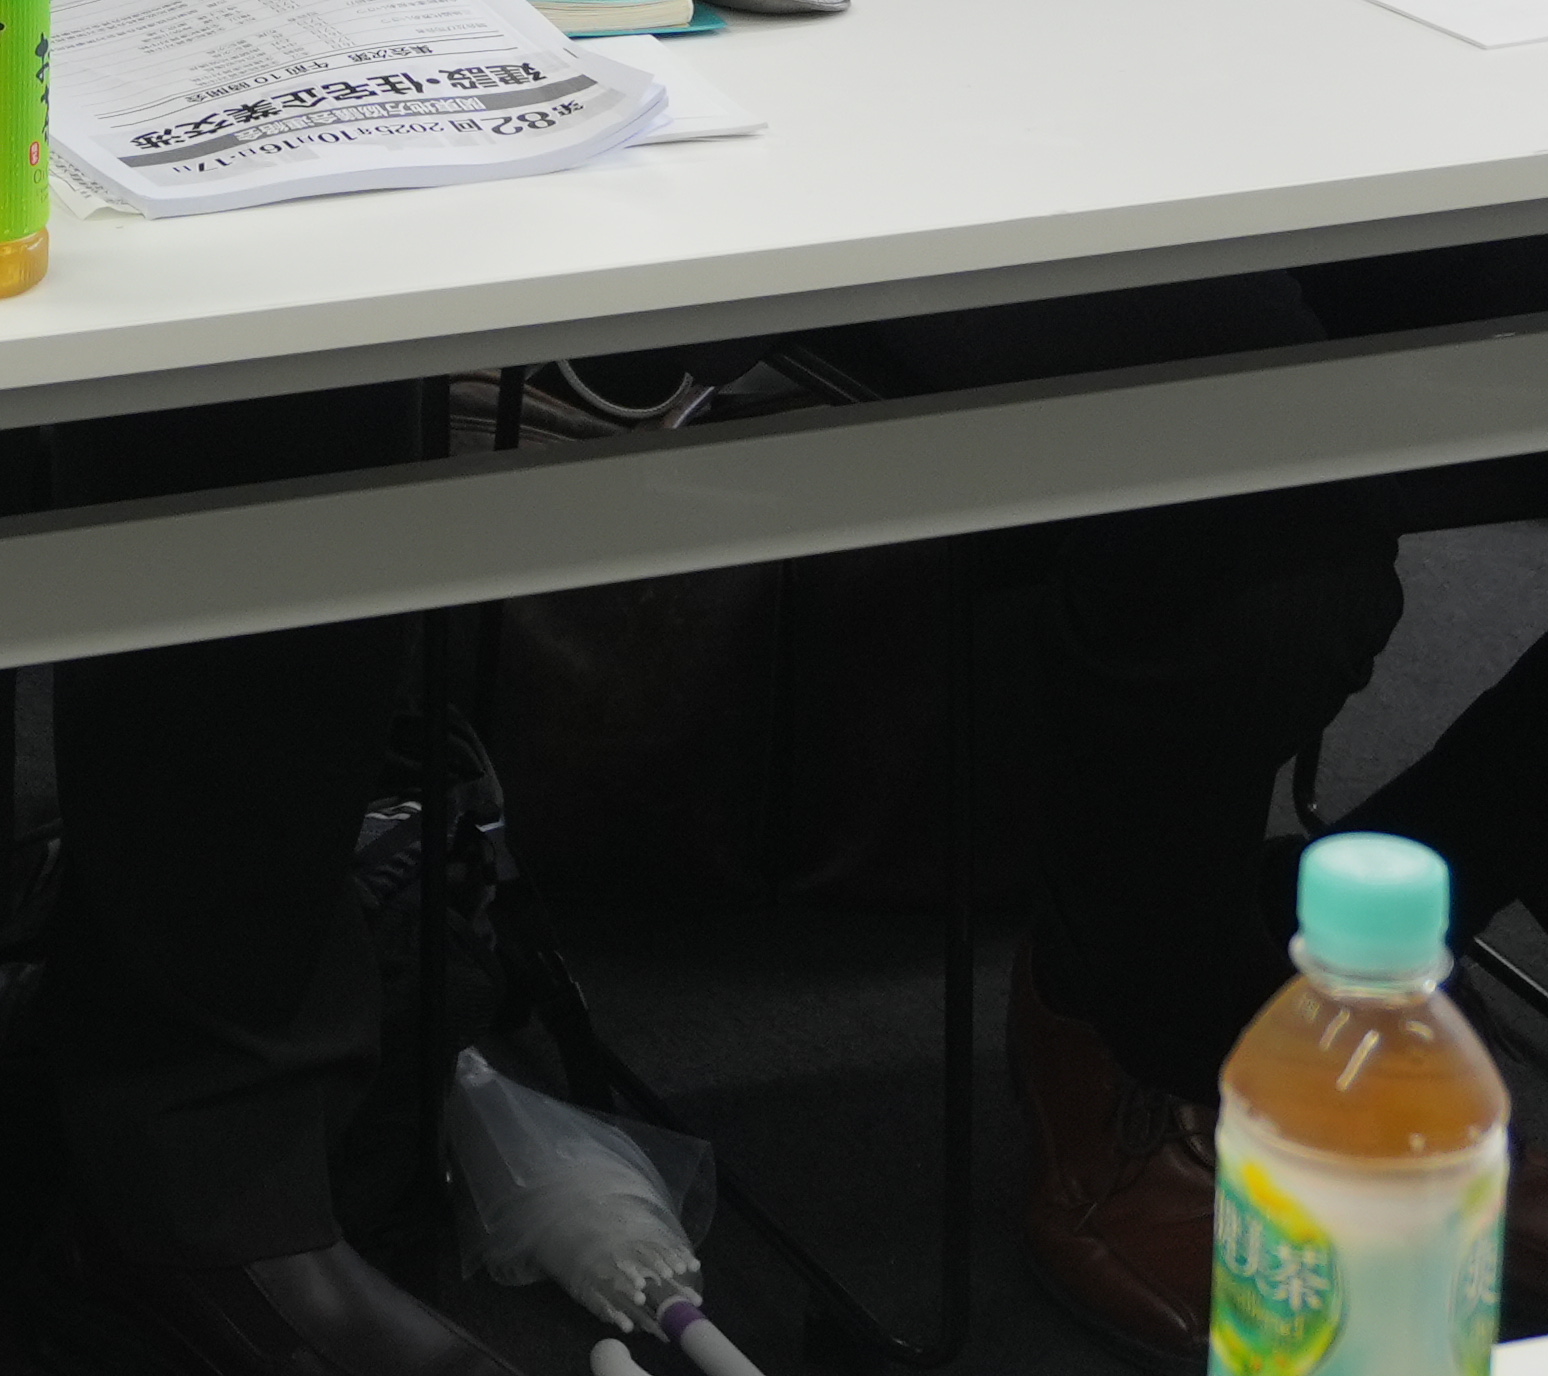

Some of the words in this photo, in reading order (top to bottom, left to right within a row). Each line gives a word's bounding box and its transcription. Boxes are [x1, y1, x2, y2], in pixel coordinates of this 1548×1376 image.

[130, 62, 548, 150] 建設・住宅企業交渉
[449, 100, 585, 136] 第82回
